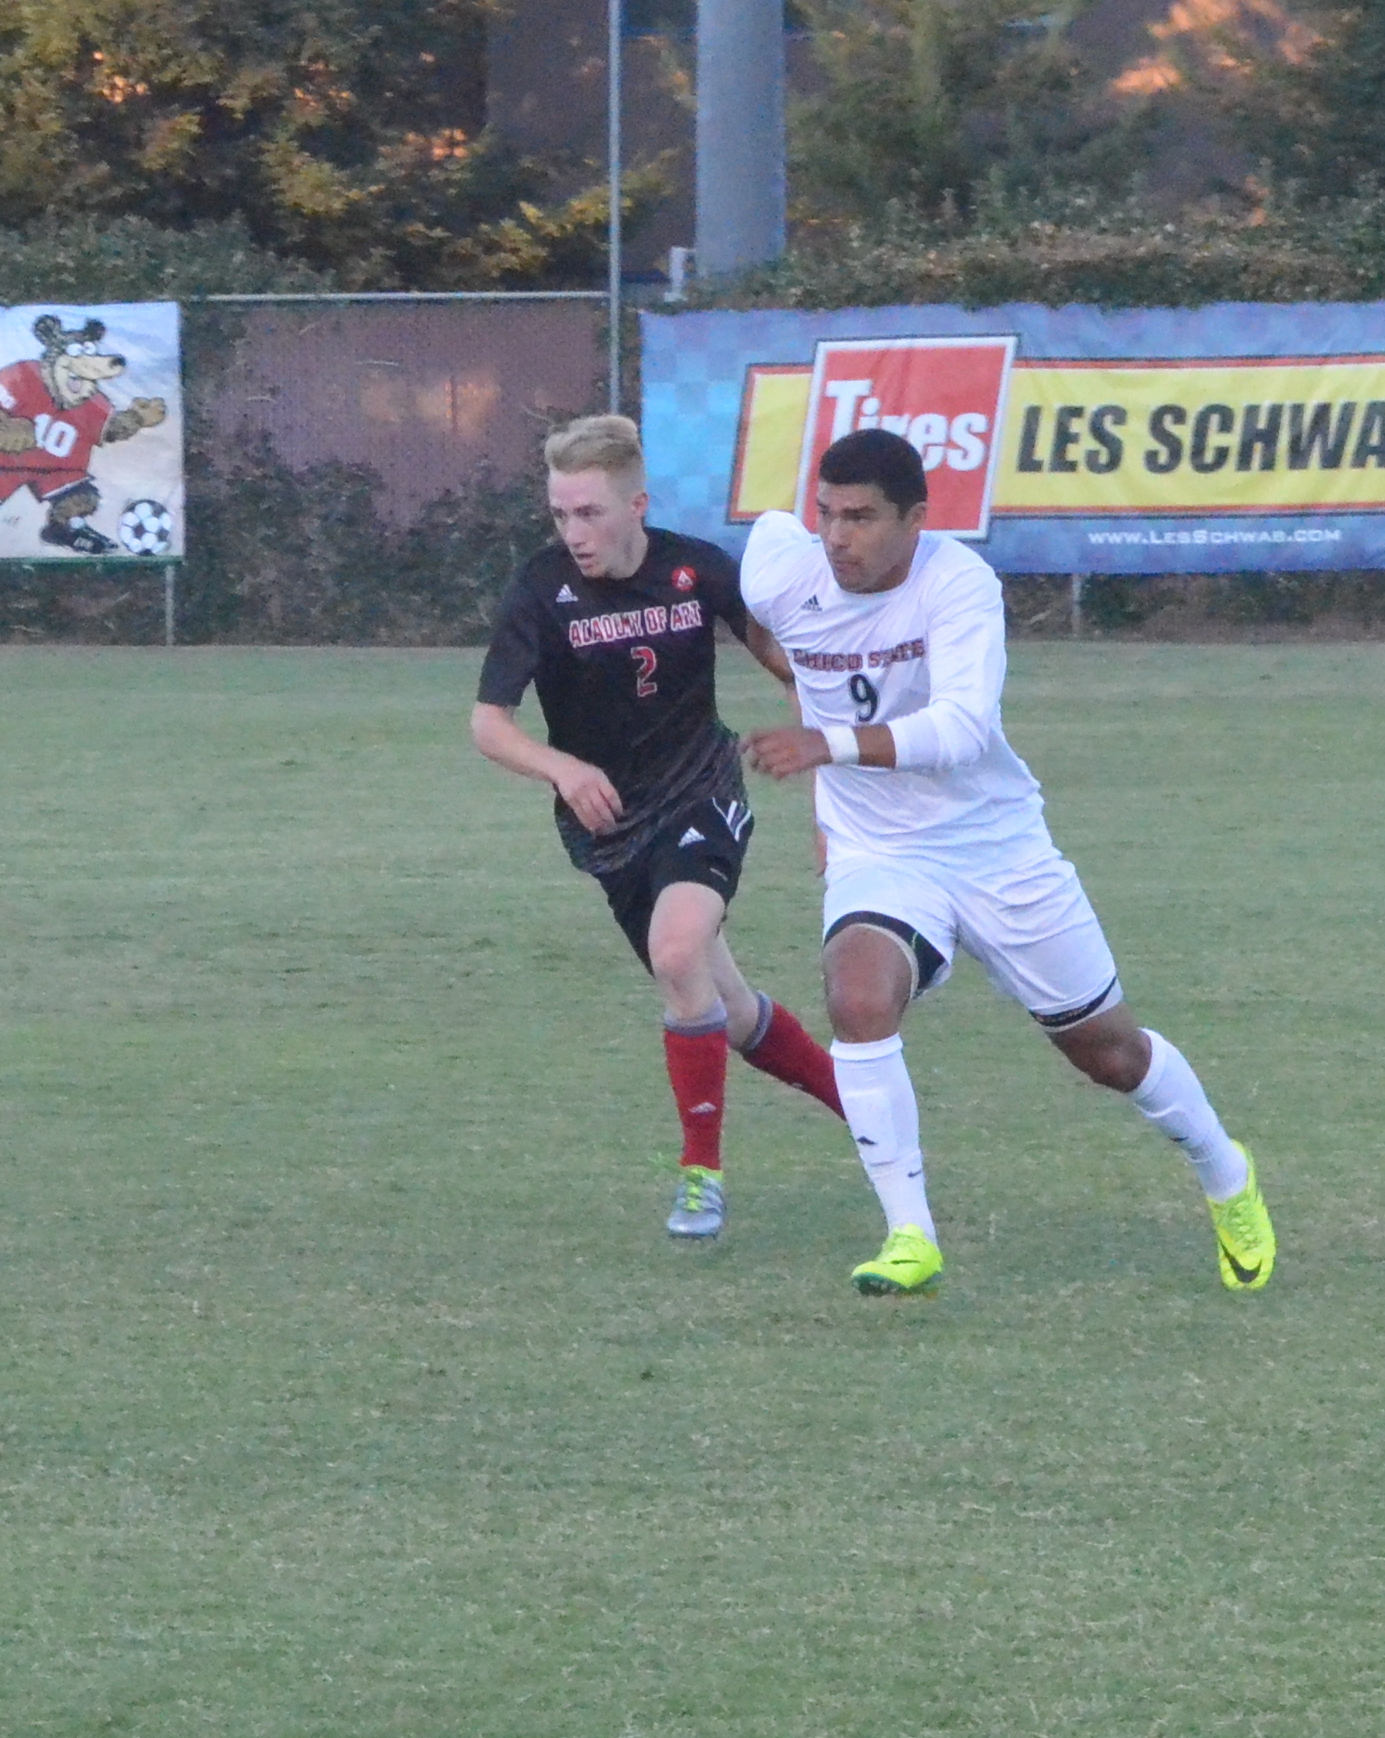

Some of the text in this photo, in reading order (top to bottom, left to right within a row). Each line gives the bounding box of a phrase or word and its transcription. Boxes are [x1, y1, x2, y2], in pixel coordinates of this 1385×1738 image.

[1017, 403, 1128, 474] LES
[631, 646, 657, 697] 2
[849, 673, 878, 723] 9
